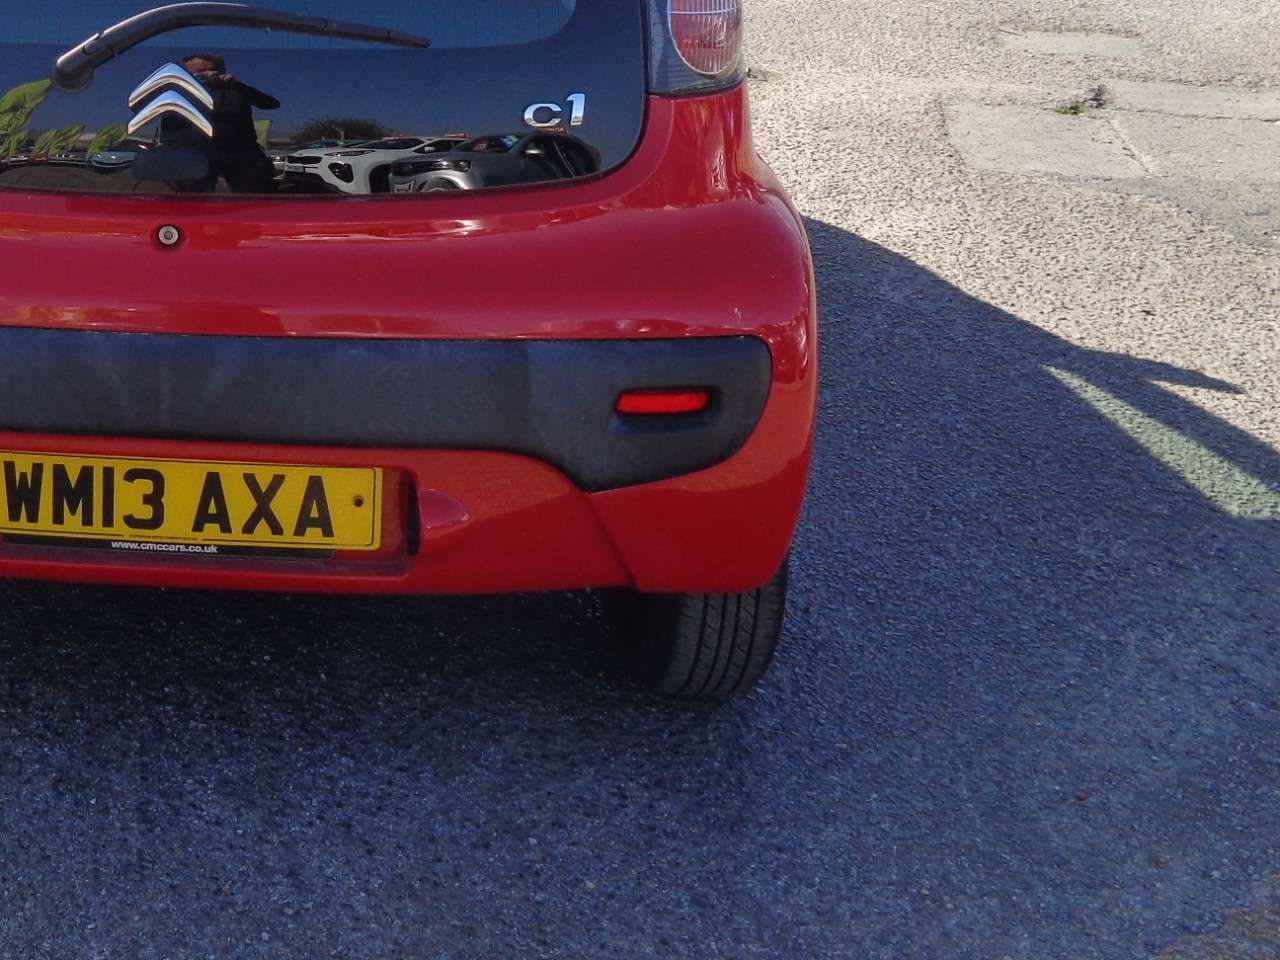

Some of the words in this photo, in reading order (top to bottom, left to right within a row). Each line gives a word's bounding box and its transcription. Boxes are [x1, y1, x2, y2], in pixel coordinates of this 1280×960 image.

[523, 93, 586, 127] C1
[3, 460, 166, 531] WM13
[191, 471, 335, 538] AXA
[111, 541, 218, 554] www.cmccars.co.uk
